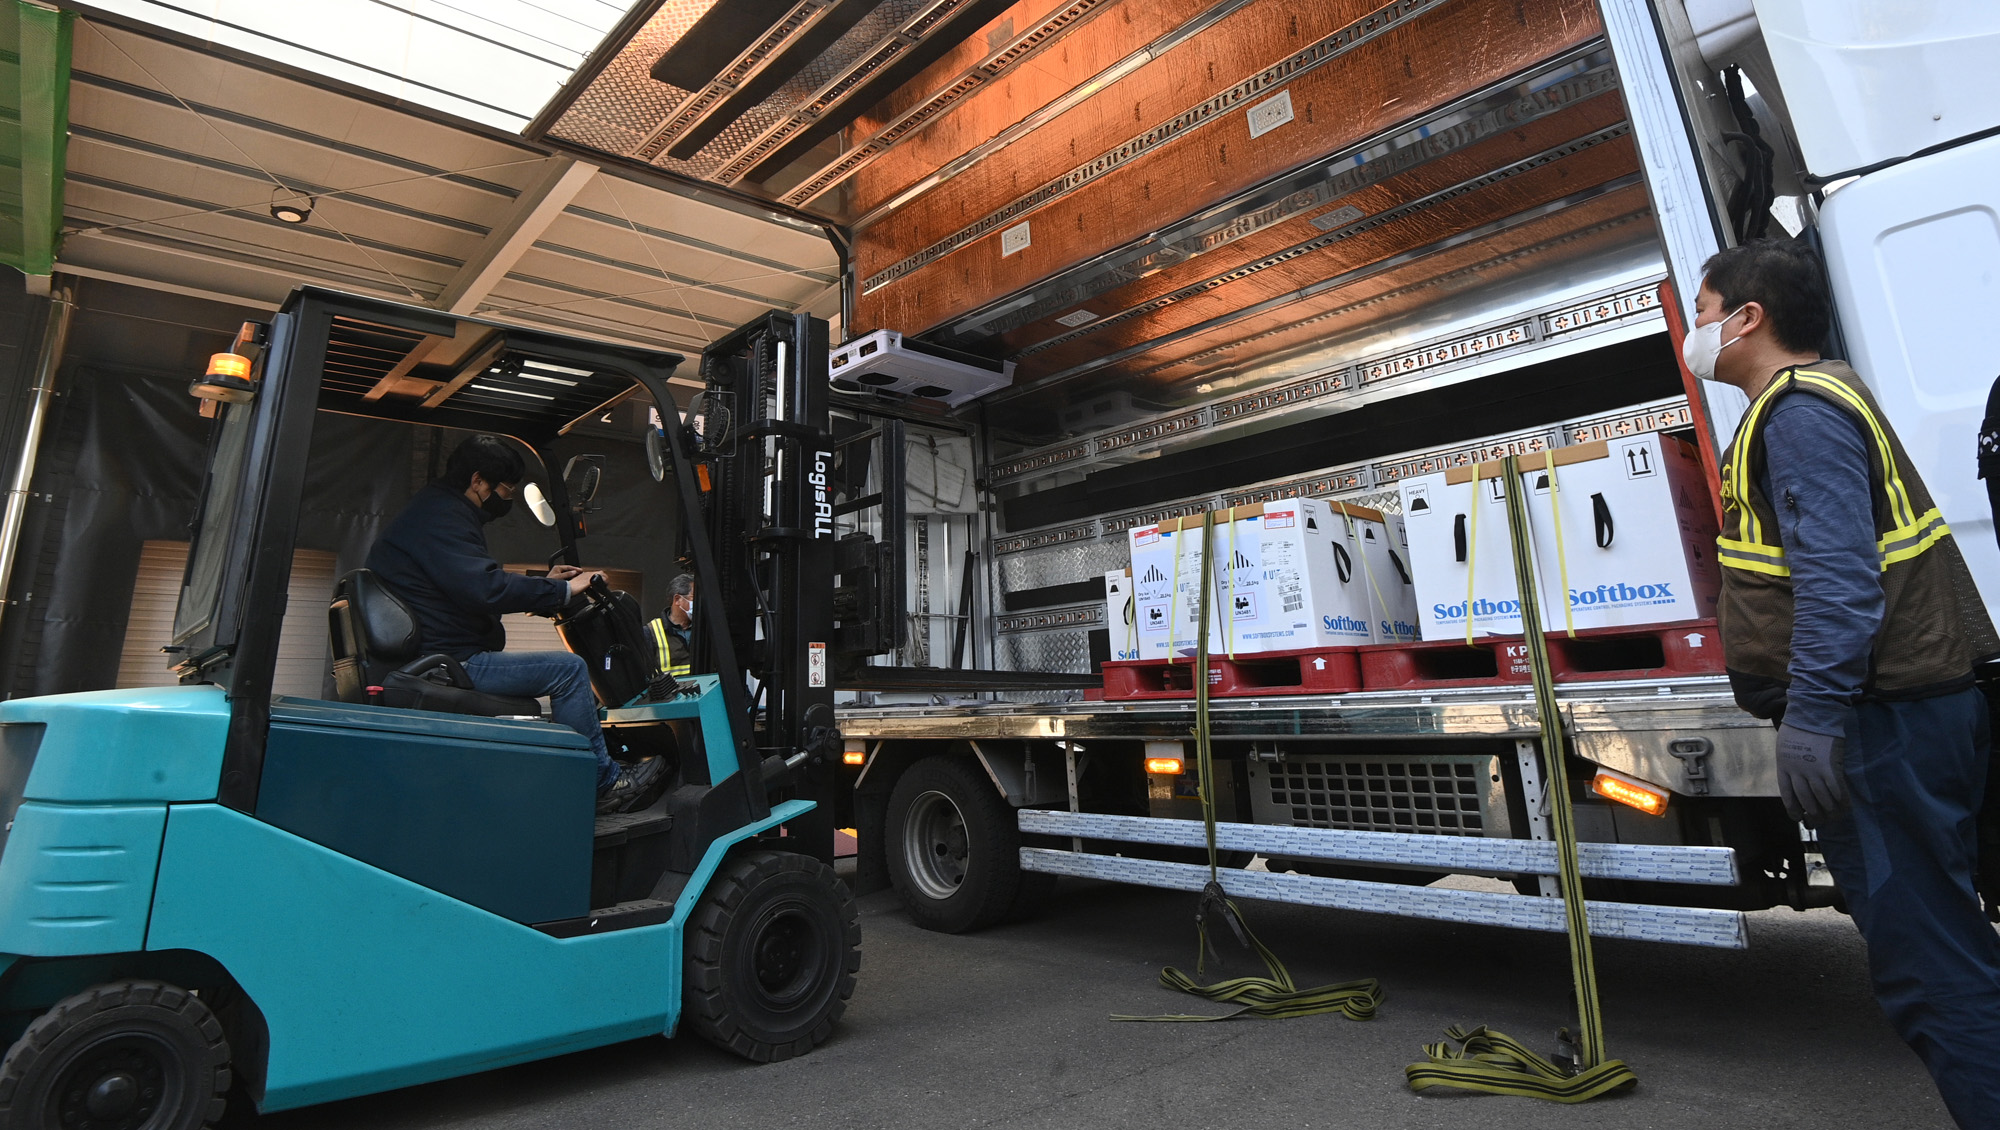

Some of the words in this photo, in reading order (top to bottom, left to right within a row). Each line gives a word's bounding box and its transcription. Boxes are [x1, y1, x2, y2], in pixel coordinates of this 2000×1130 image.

[808, 450, 832, 539] LogisALL
[1408, 488, 1426, 496] HEAVY
[1569, 582, 1674, 607] Softbox
[1433, 598, 1520, 620] Softbox
[1323, 614, 1368, 632] Softbox
